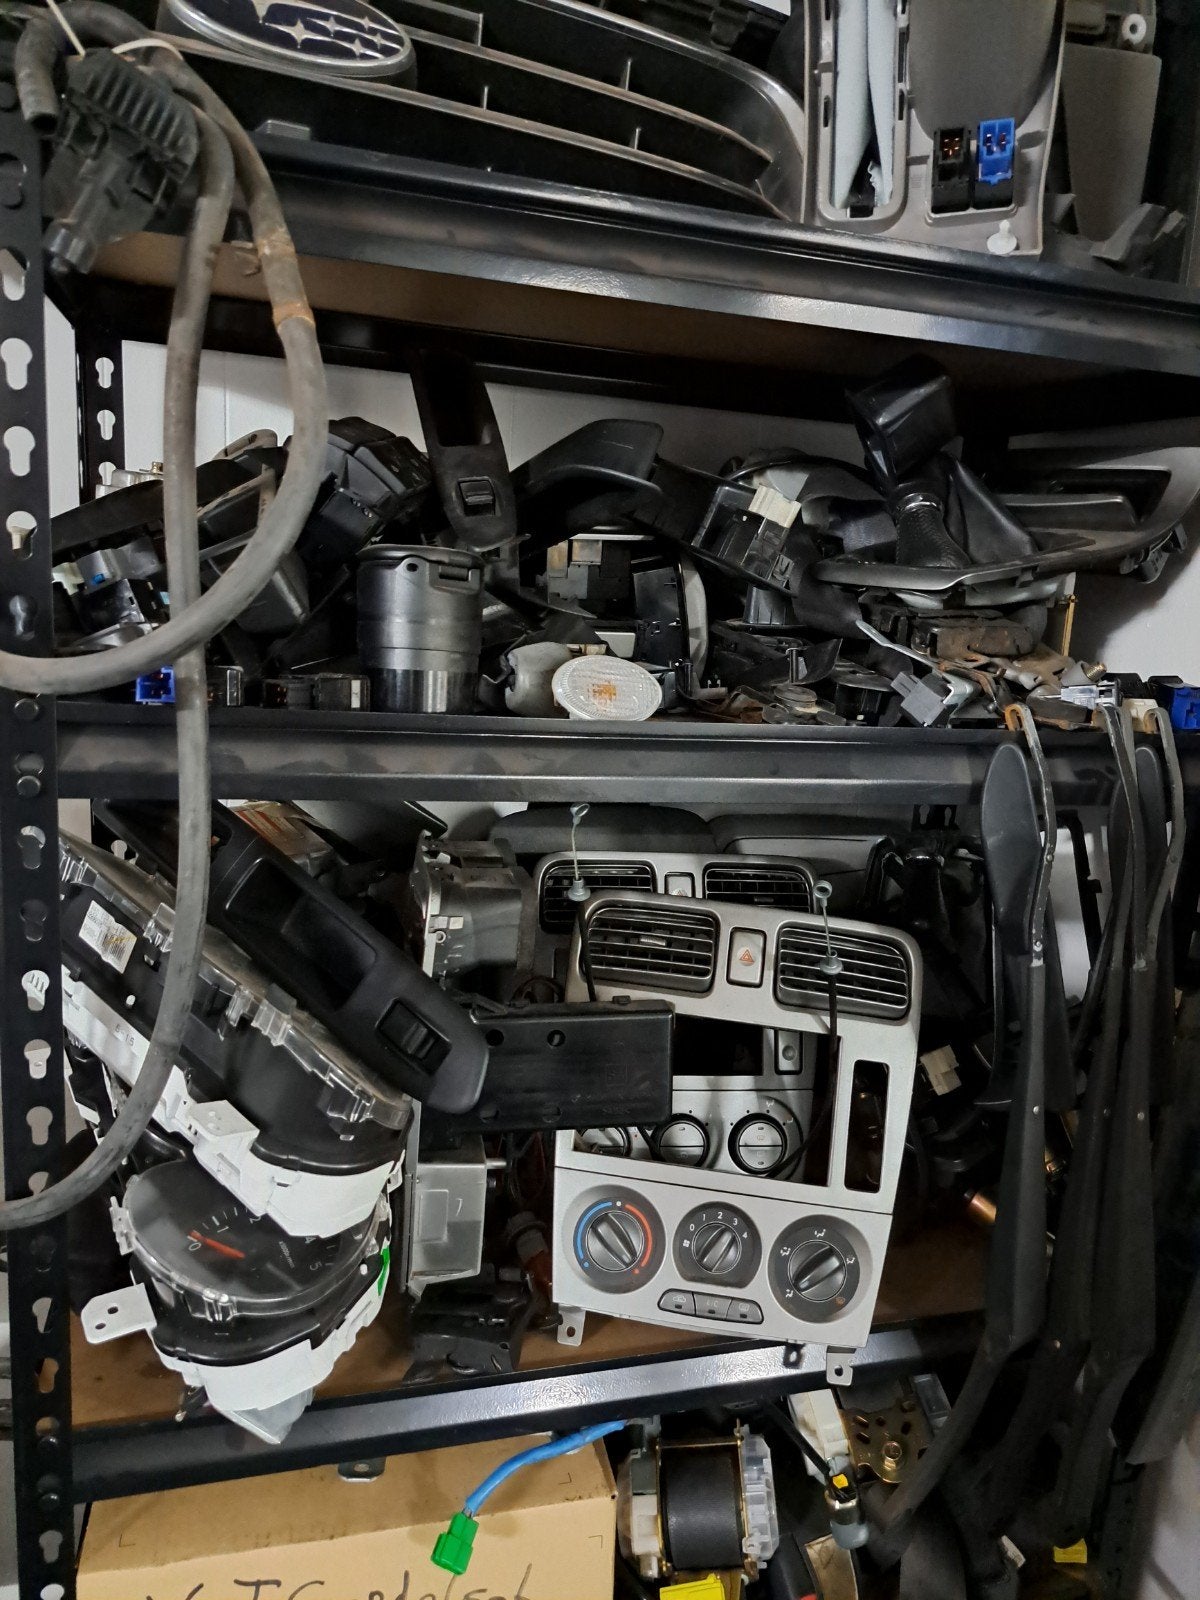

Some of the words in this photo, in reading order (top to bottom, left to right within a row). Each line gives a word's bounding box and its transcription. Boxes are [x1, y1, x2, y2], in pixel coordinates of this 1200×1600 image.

[216, 1225, 229, 1233] 1
[689, 1223, 695, 1231] 0
[702, 1213, 707, 1221] 1
[717, 1211, 723, 1220] 2
[733, 1217, 738, 1226] 3
[742, 1231, 748, 1239] 4
[188, 1242, 202, 1251] 0
[309, 1261, 322, 1271] 5
